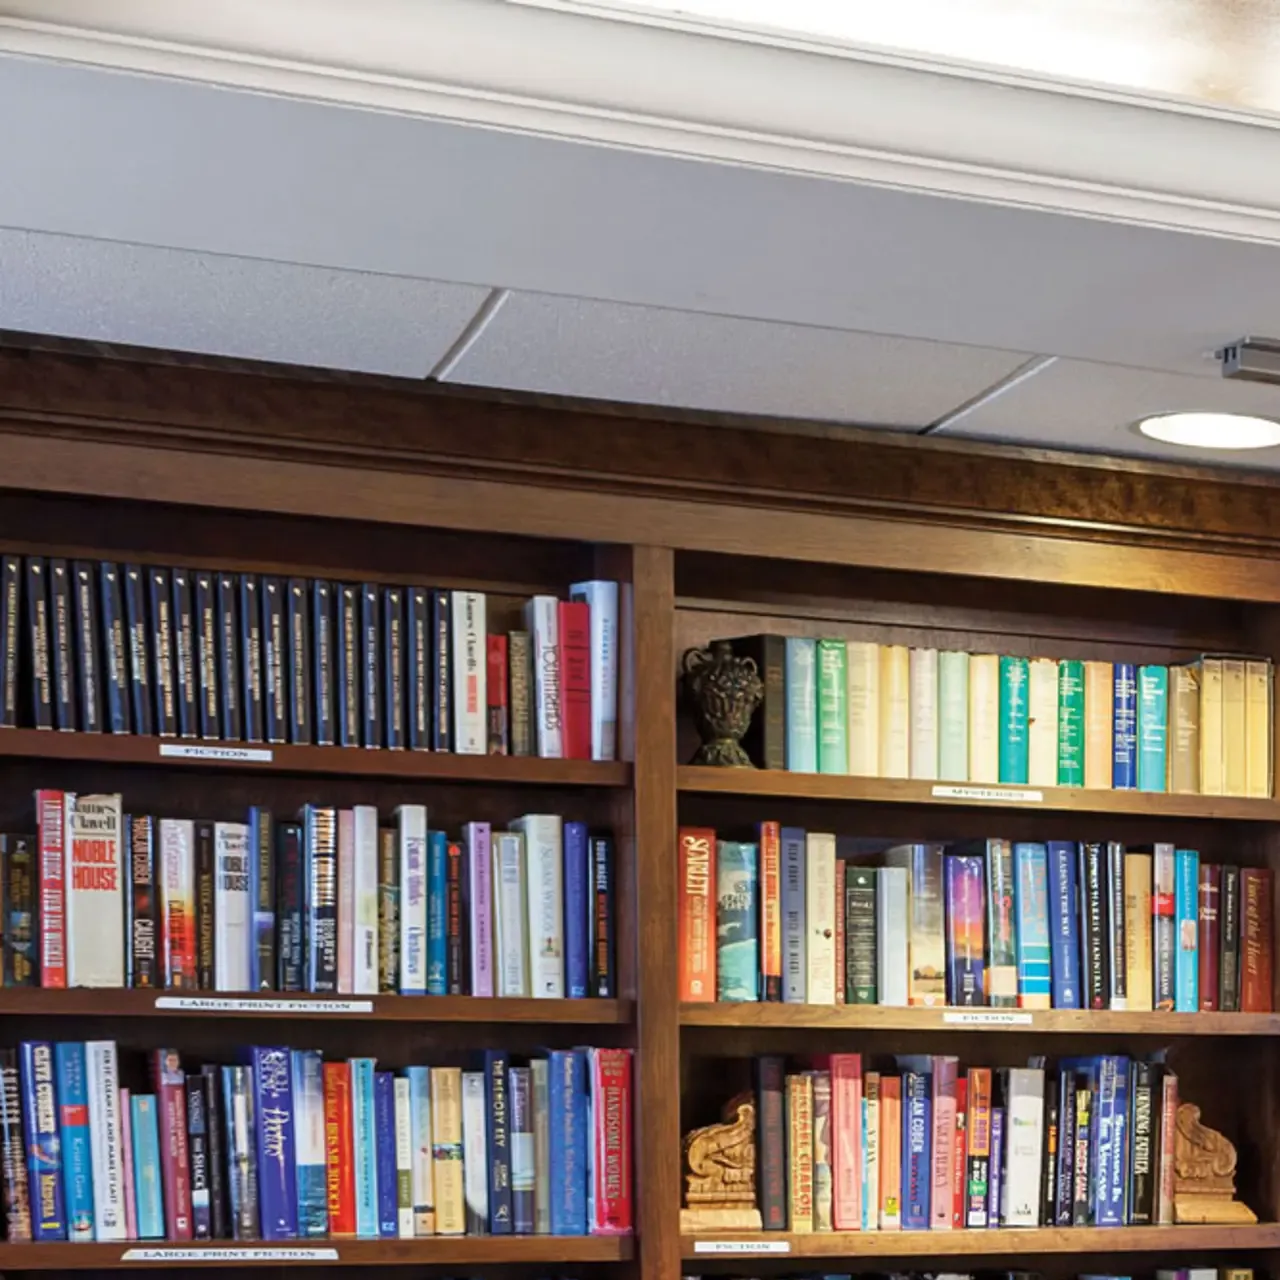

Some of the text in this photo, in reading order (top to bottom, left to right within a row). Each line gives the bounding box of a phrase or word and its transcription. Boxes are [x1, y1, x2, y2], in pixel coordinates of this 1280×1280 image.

[184, 748, 248, 757] FICTION
[72, 839, 117, 862] NOBLE
[684, 837, 711, 896] SCARLETT
[73, 867, 117, 892] HOUSE
[1091, 892, 1100, 932] HARRIS
[133, 919, 154, 959] CAUGHT
[1092, 937, 1103, 995] HANNIBAL
[494, 1060, 503, 1076] THE
[495, 1130, 504, 1147] KEY
[605, 1087, 621, 1198] HANDSOME WOMEN
[912, 1118, 925, 1152] COBEN
[193, 1154, 206, 1188] SHACK
